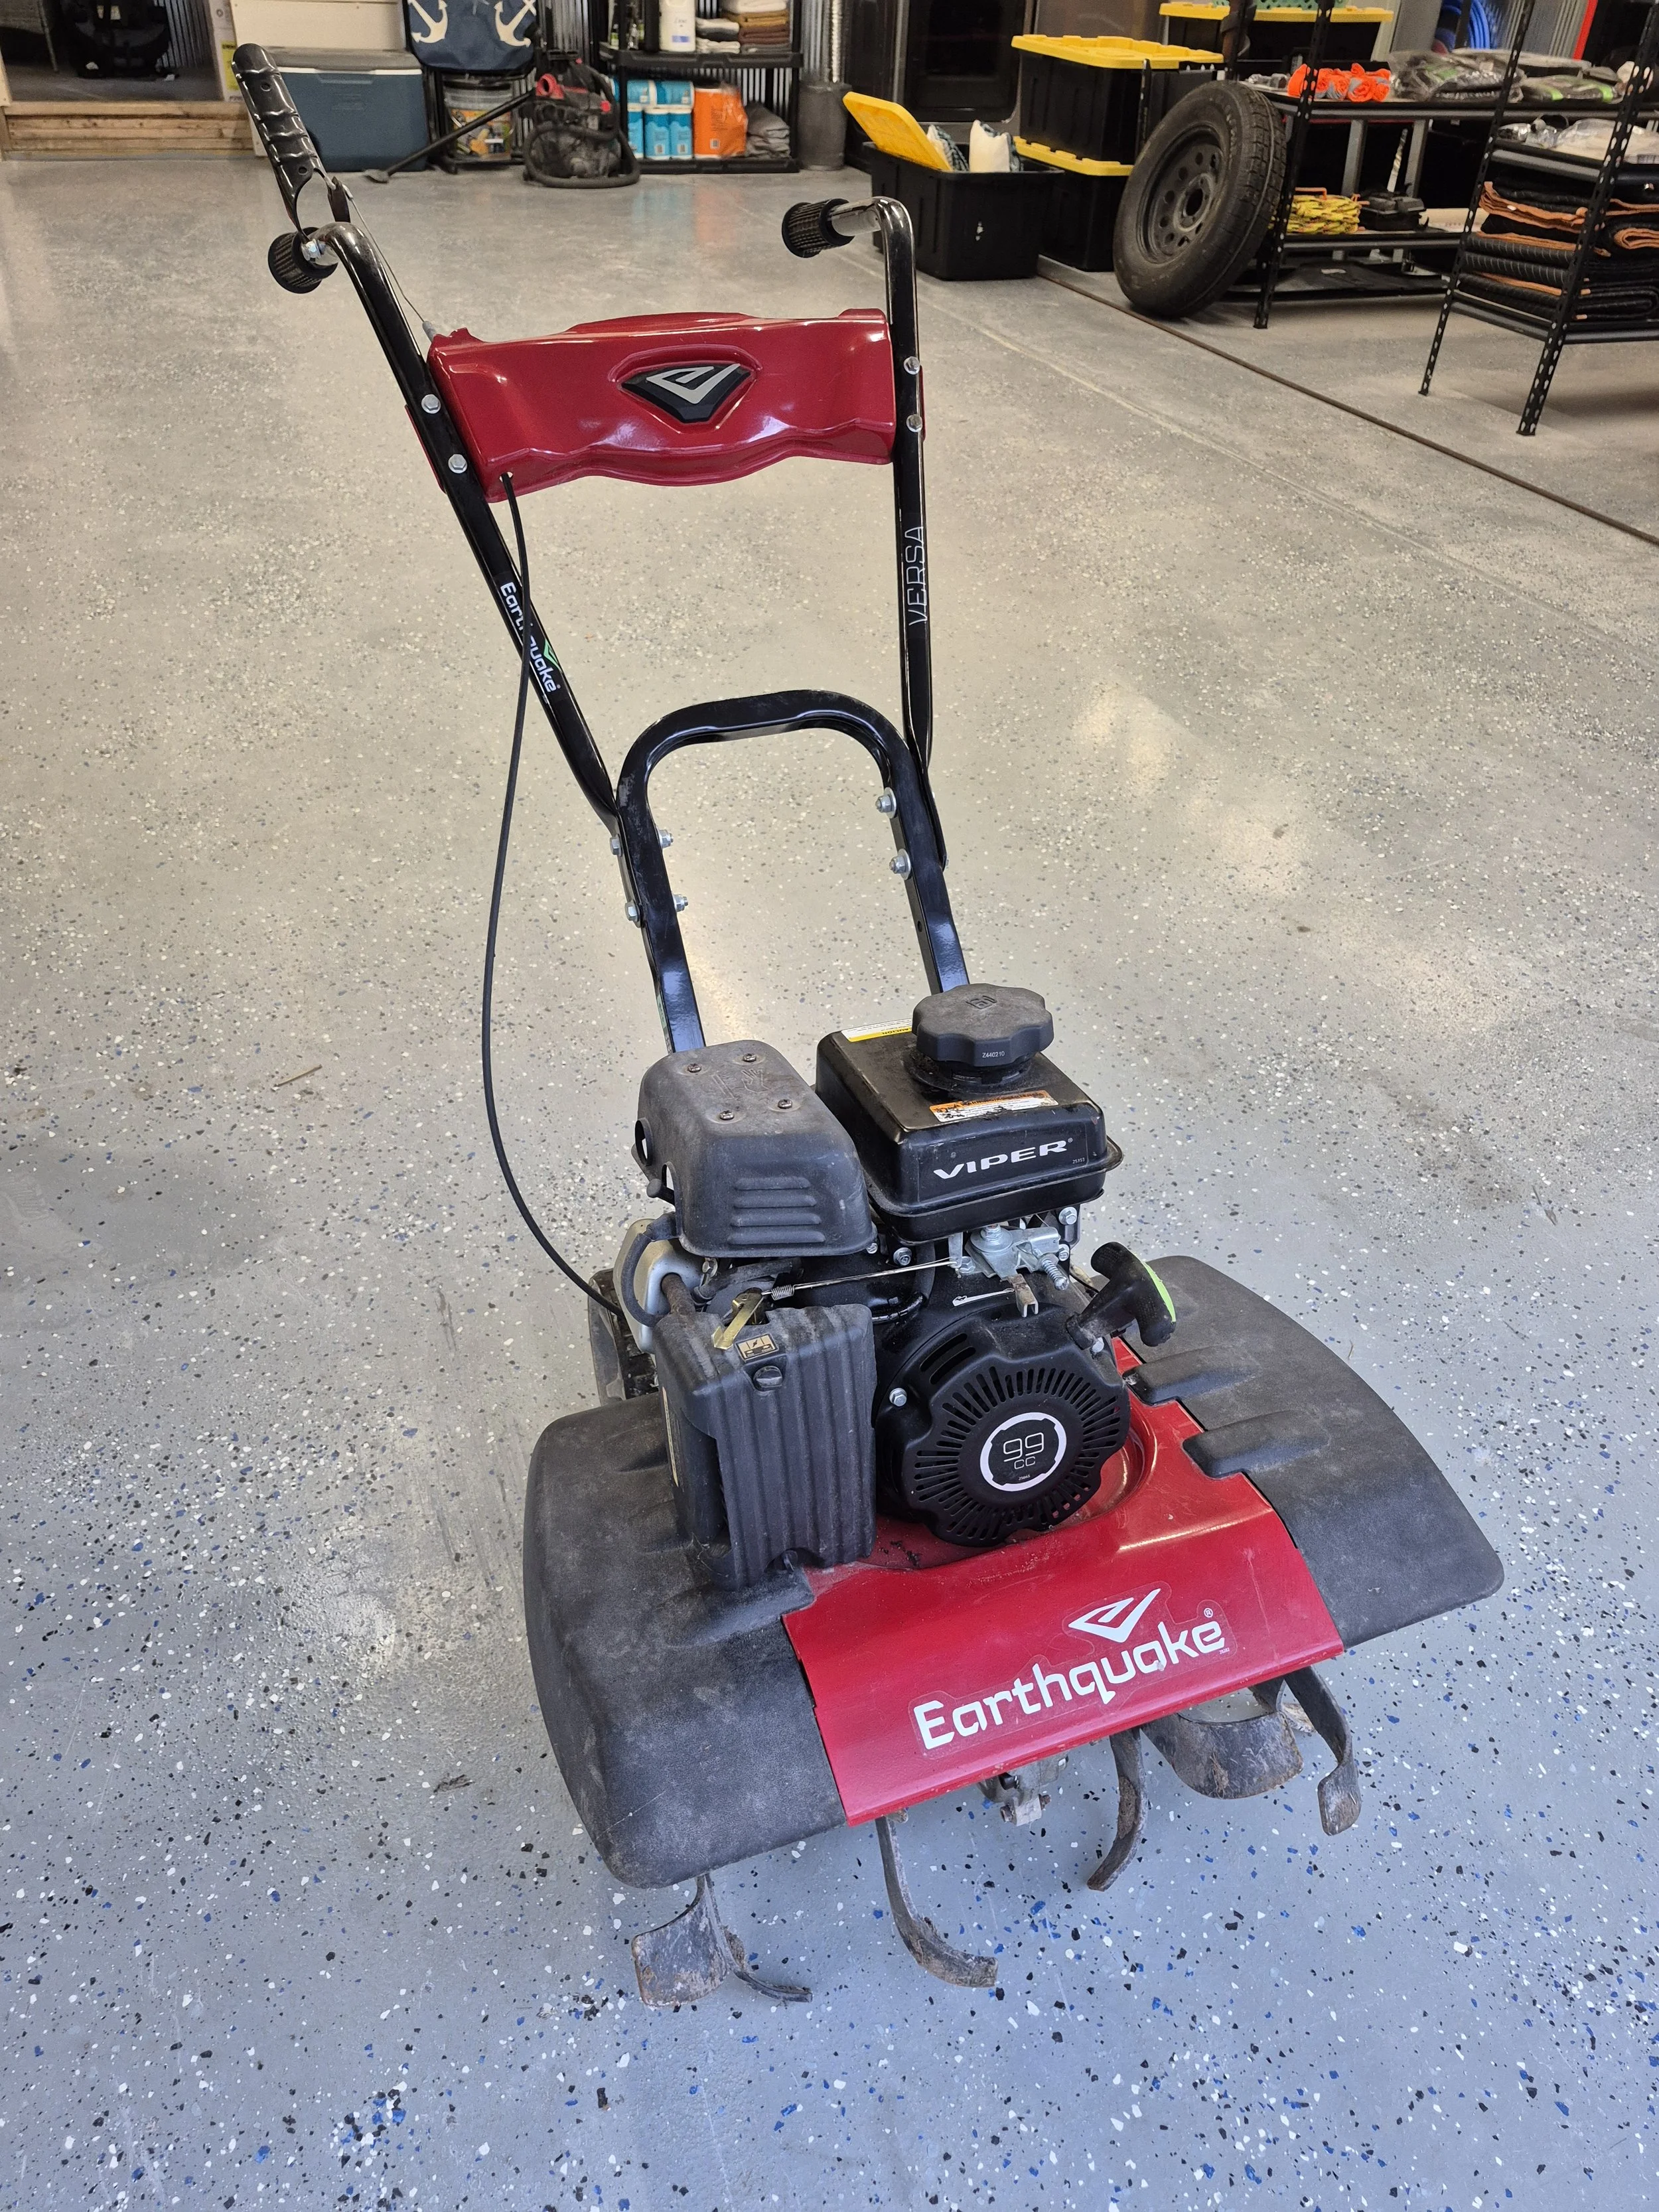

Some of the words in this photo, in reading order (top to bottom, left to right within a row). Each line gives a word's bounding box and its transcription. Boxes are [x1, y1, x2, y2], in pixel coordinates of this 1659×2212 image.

[904, 526, 928, 626] VERSA
[934, 1140, 1068, 1179] VIPER
[1003, 1432, 1045, 1463] 99
[913, 1621, 1225, 1750] Earthquake
